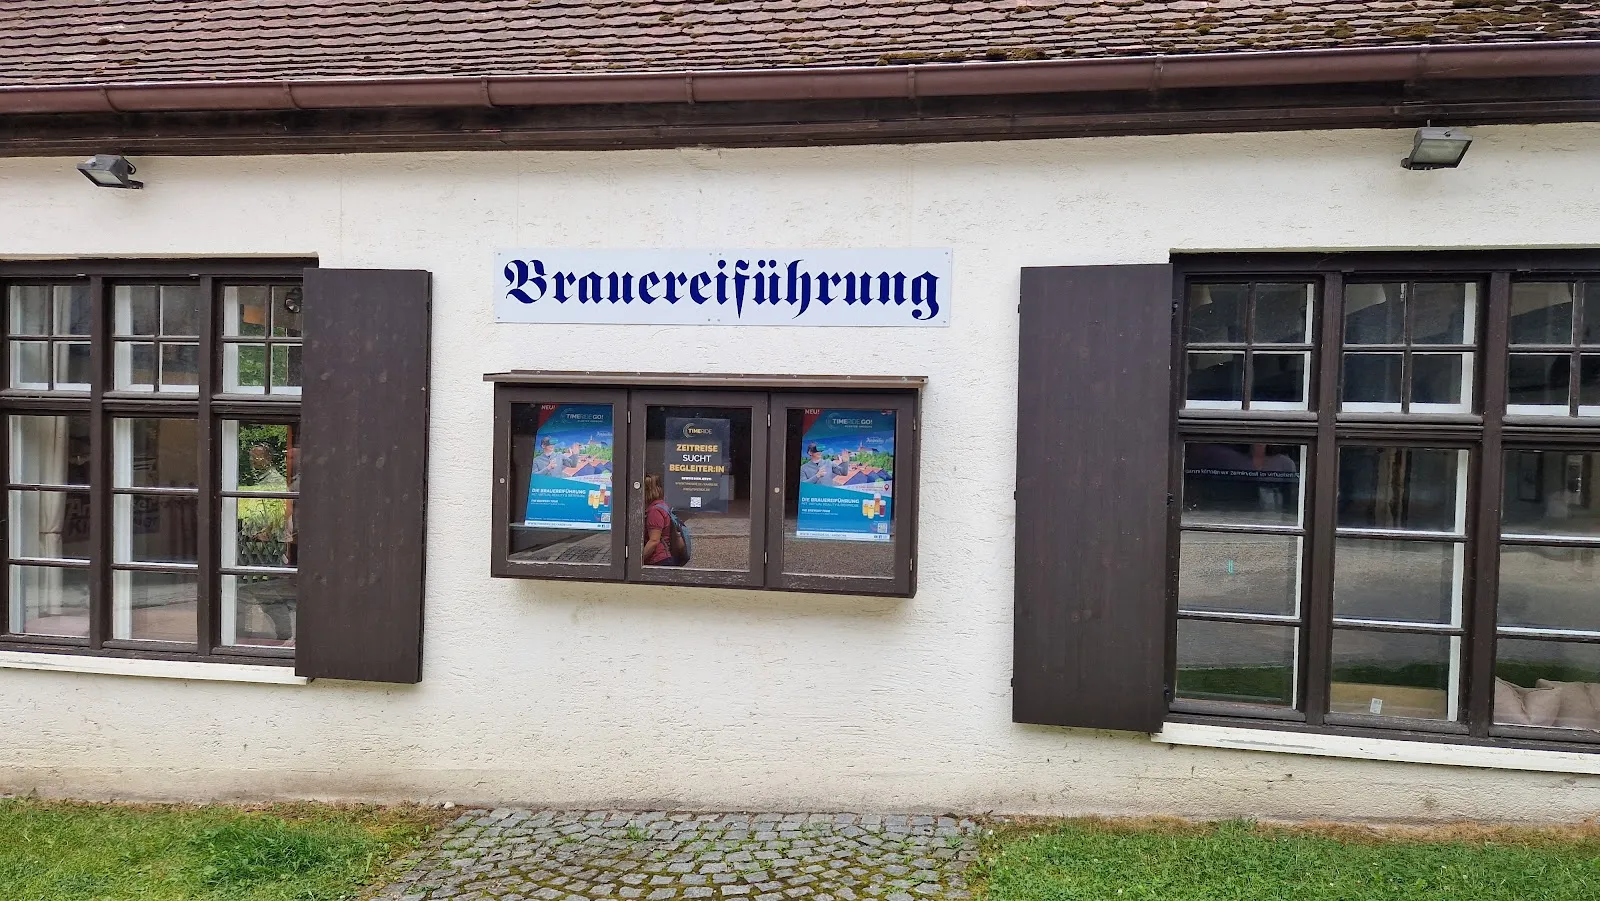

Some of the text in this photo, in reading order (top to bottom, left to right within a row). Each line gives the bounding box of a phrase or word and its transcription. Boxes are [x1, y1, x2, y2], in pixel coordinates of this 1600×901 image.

[504, 259, 940, 320] Brauereiführung
[676, 443, 719, 453] ZEITREISE
[682, 454, 712, 463] SUCHT
[669, 463, 725, 473] BEGLEITER:IN
